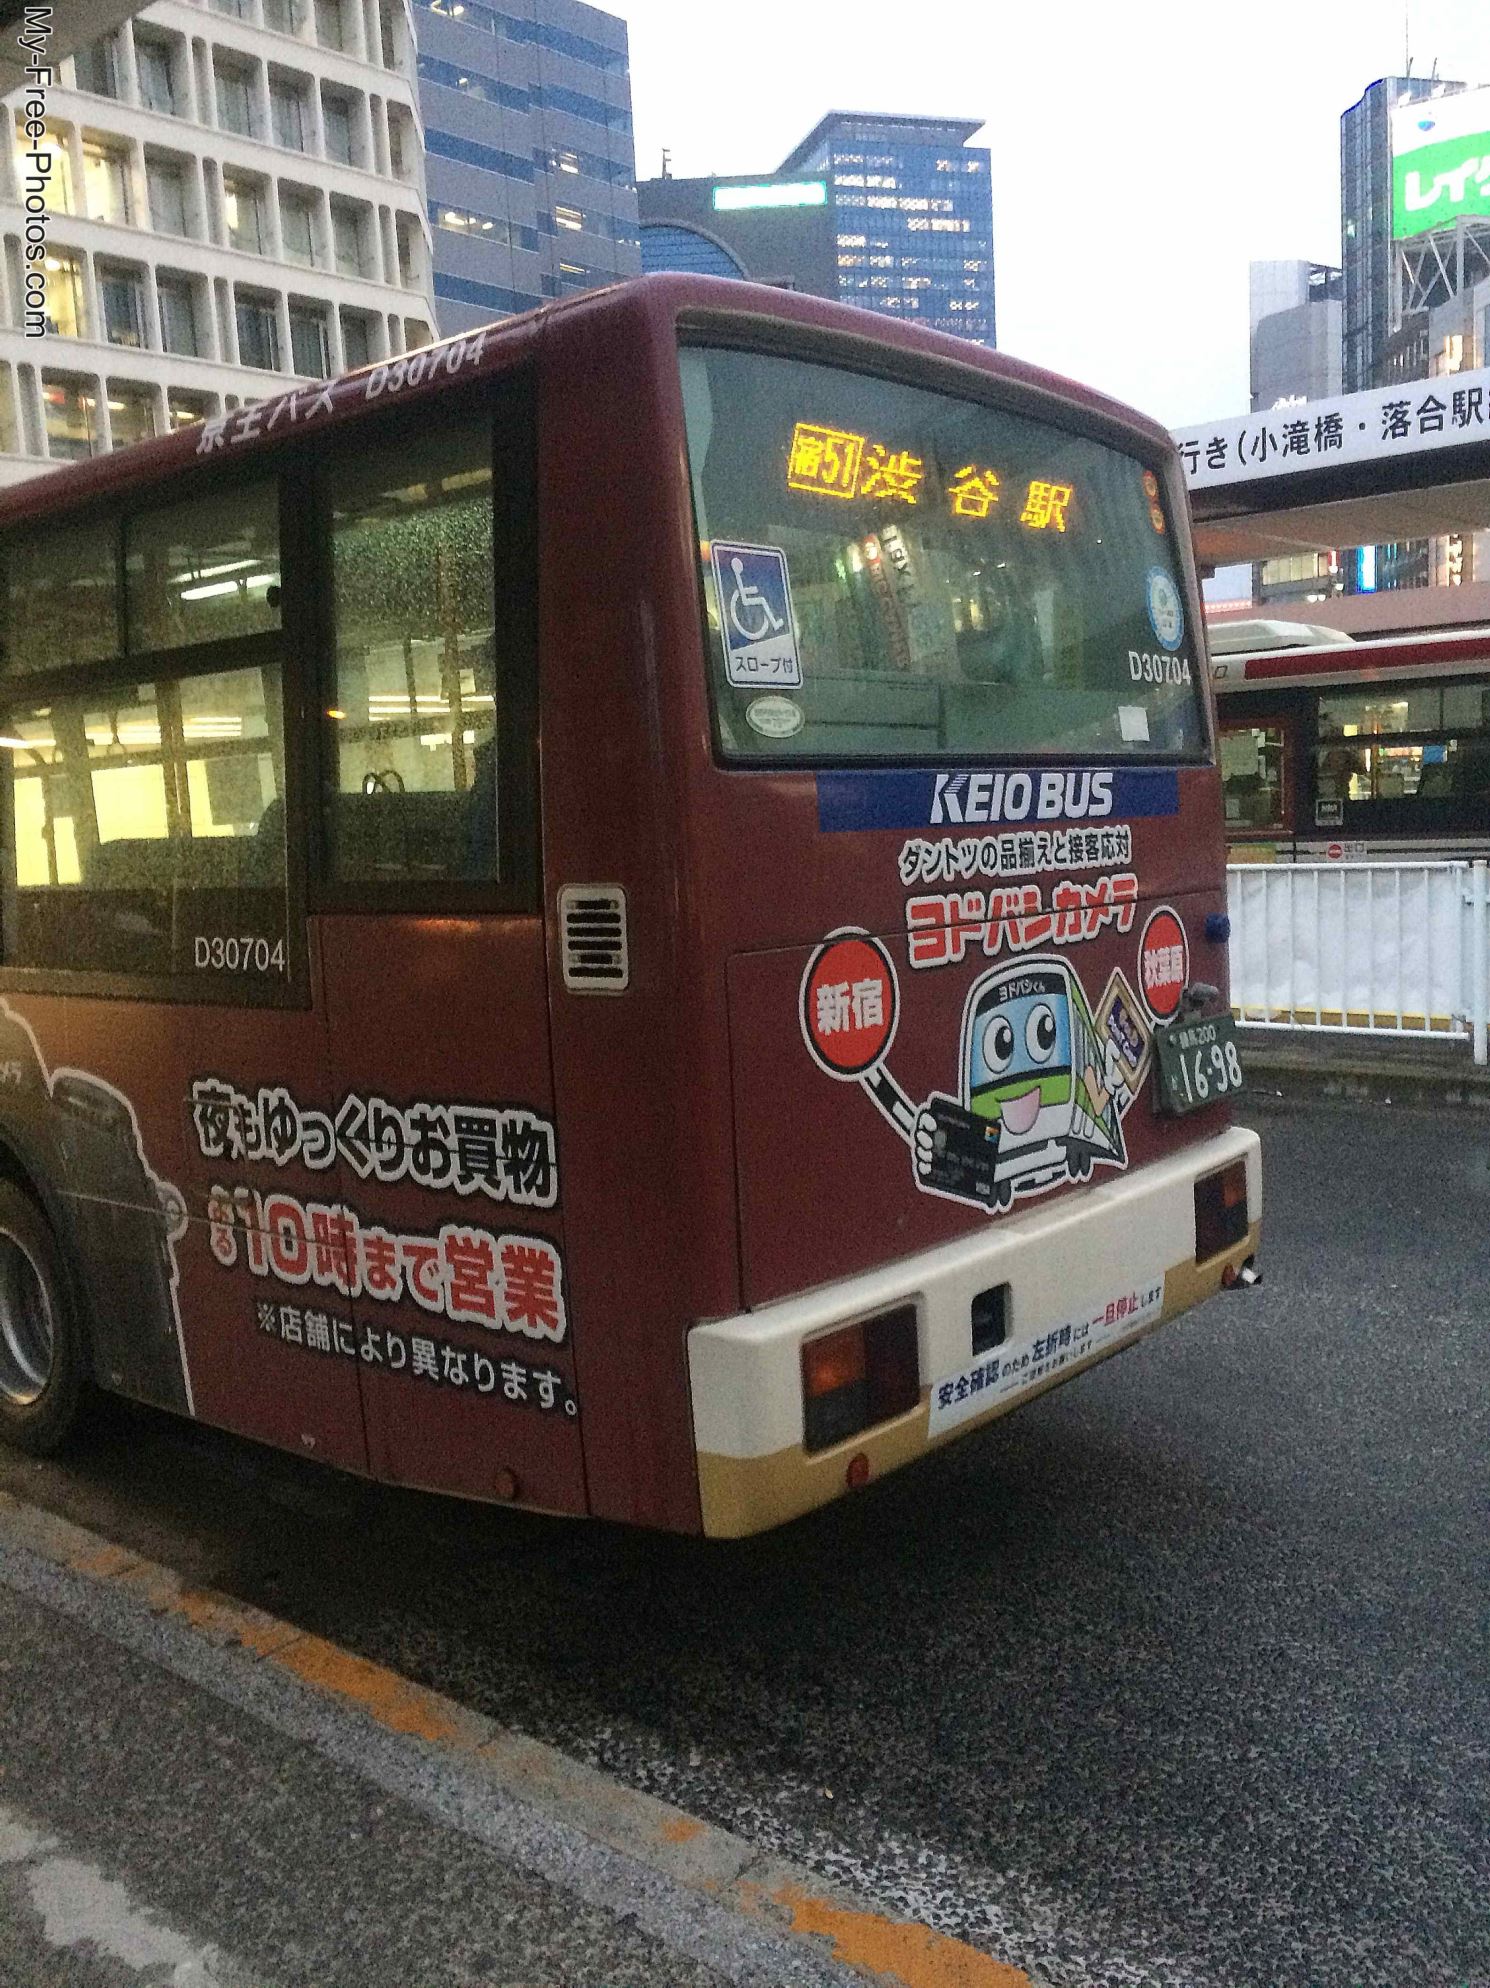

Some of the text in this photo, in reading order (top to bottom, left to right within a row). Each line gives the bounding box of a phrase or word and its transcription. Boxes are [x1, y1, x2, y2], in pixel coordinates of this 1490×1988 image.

[196, 331, 487, 454] 京王バス D30704
[735, 656, 793, 674] スロープ付
[1128, 650, 1192, 686] D30704
[929, 772, 1114, 824] KEIO BUS
[899, 825, 1133, 886] ダントツの品揃えと接客応対
[906, 873, 1138, 969] ヨドバシカメラ
[193, 936, 286, 973] D30704
[816, 978, 884, 1036] 新宿
